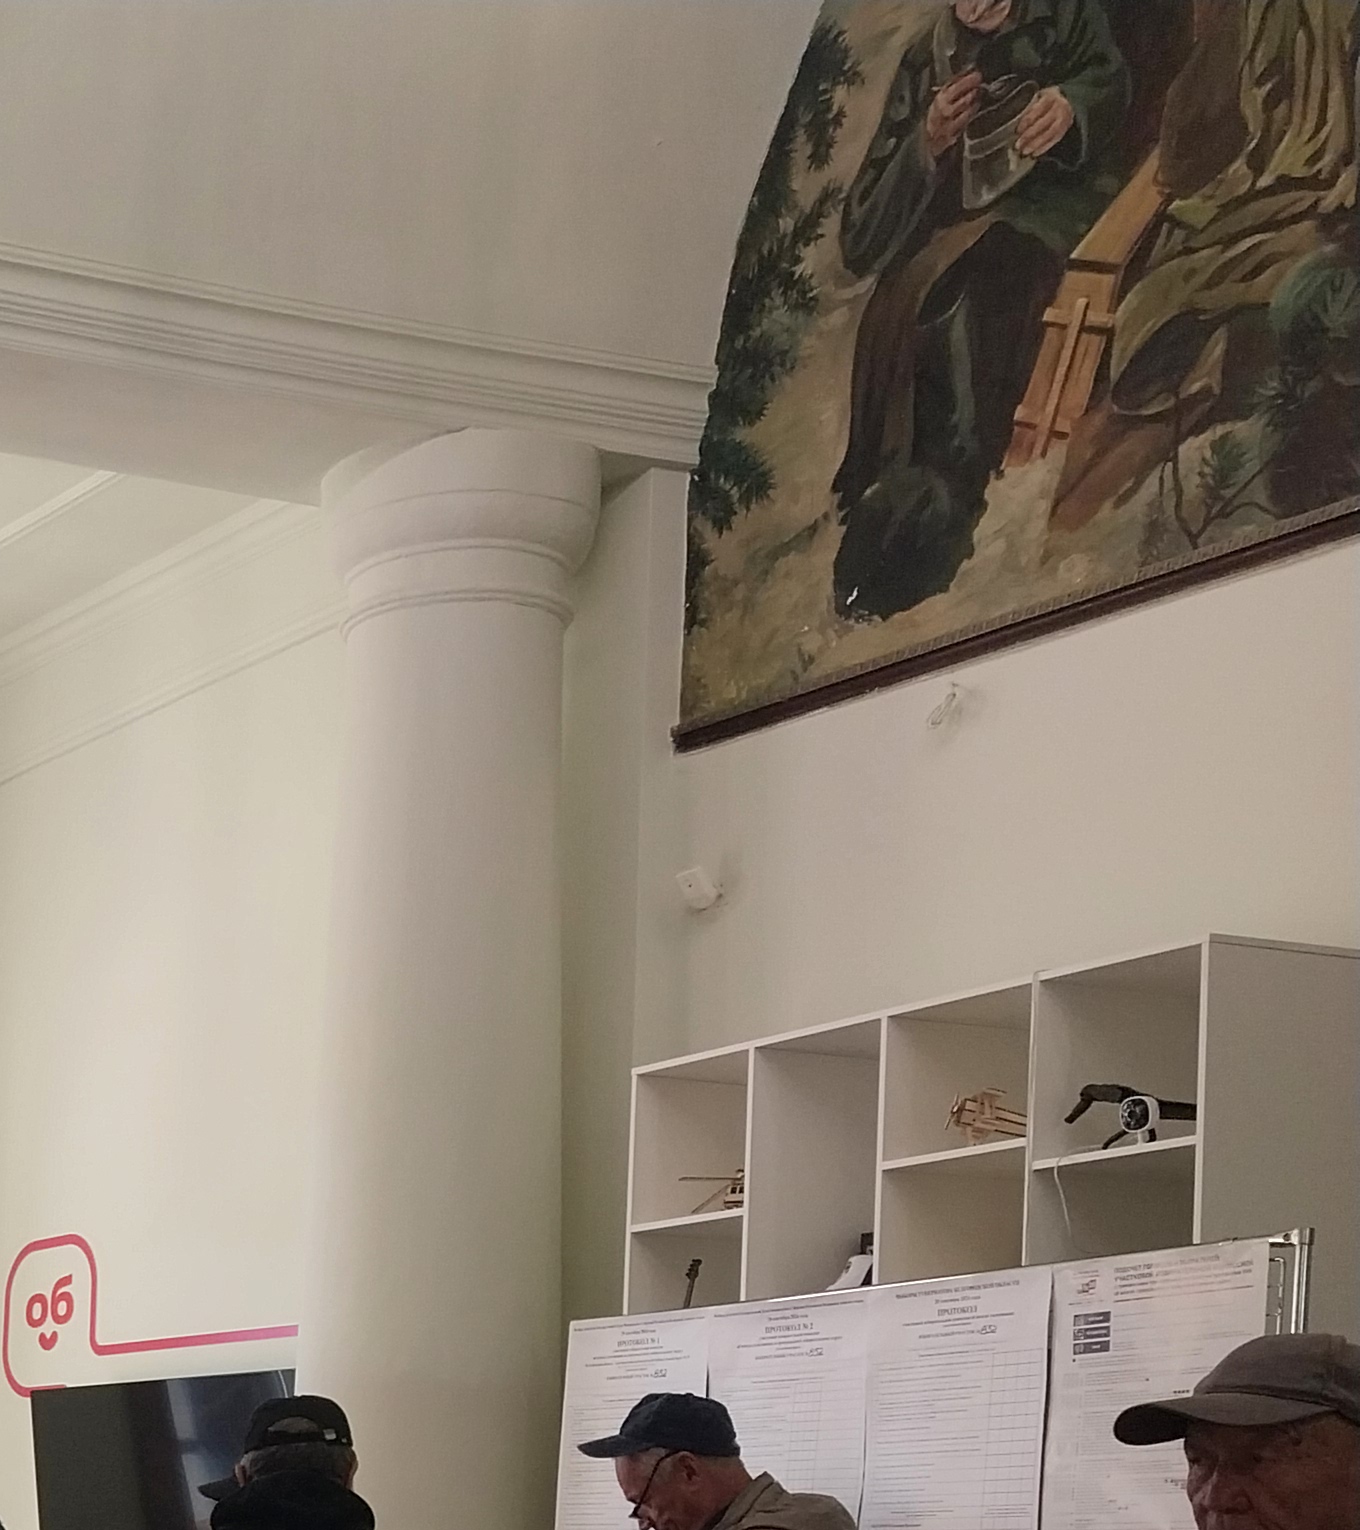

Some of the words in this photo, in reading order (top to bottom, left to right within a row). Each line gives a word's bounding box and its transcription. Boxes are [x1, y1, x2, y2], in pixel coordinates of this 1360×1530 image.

[25, 1273, 74, 1329] об
[937, 1305, 978, 1316] ПРОТОКОЛ
[765, 1323, 801, 1333] ПРОТОКОЛ
[617, 1338, 649, 1348] ПРОТОКОЛ
